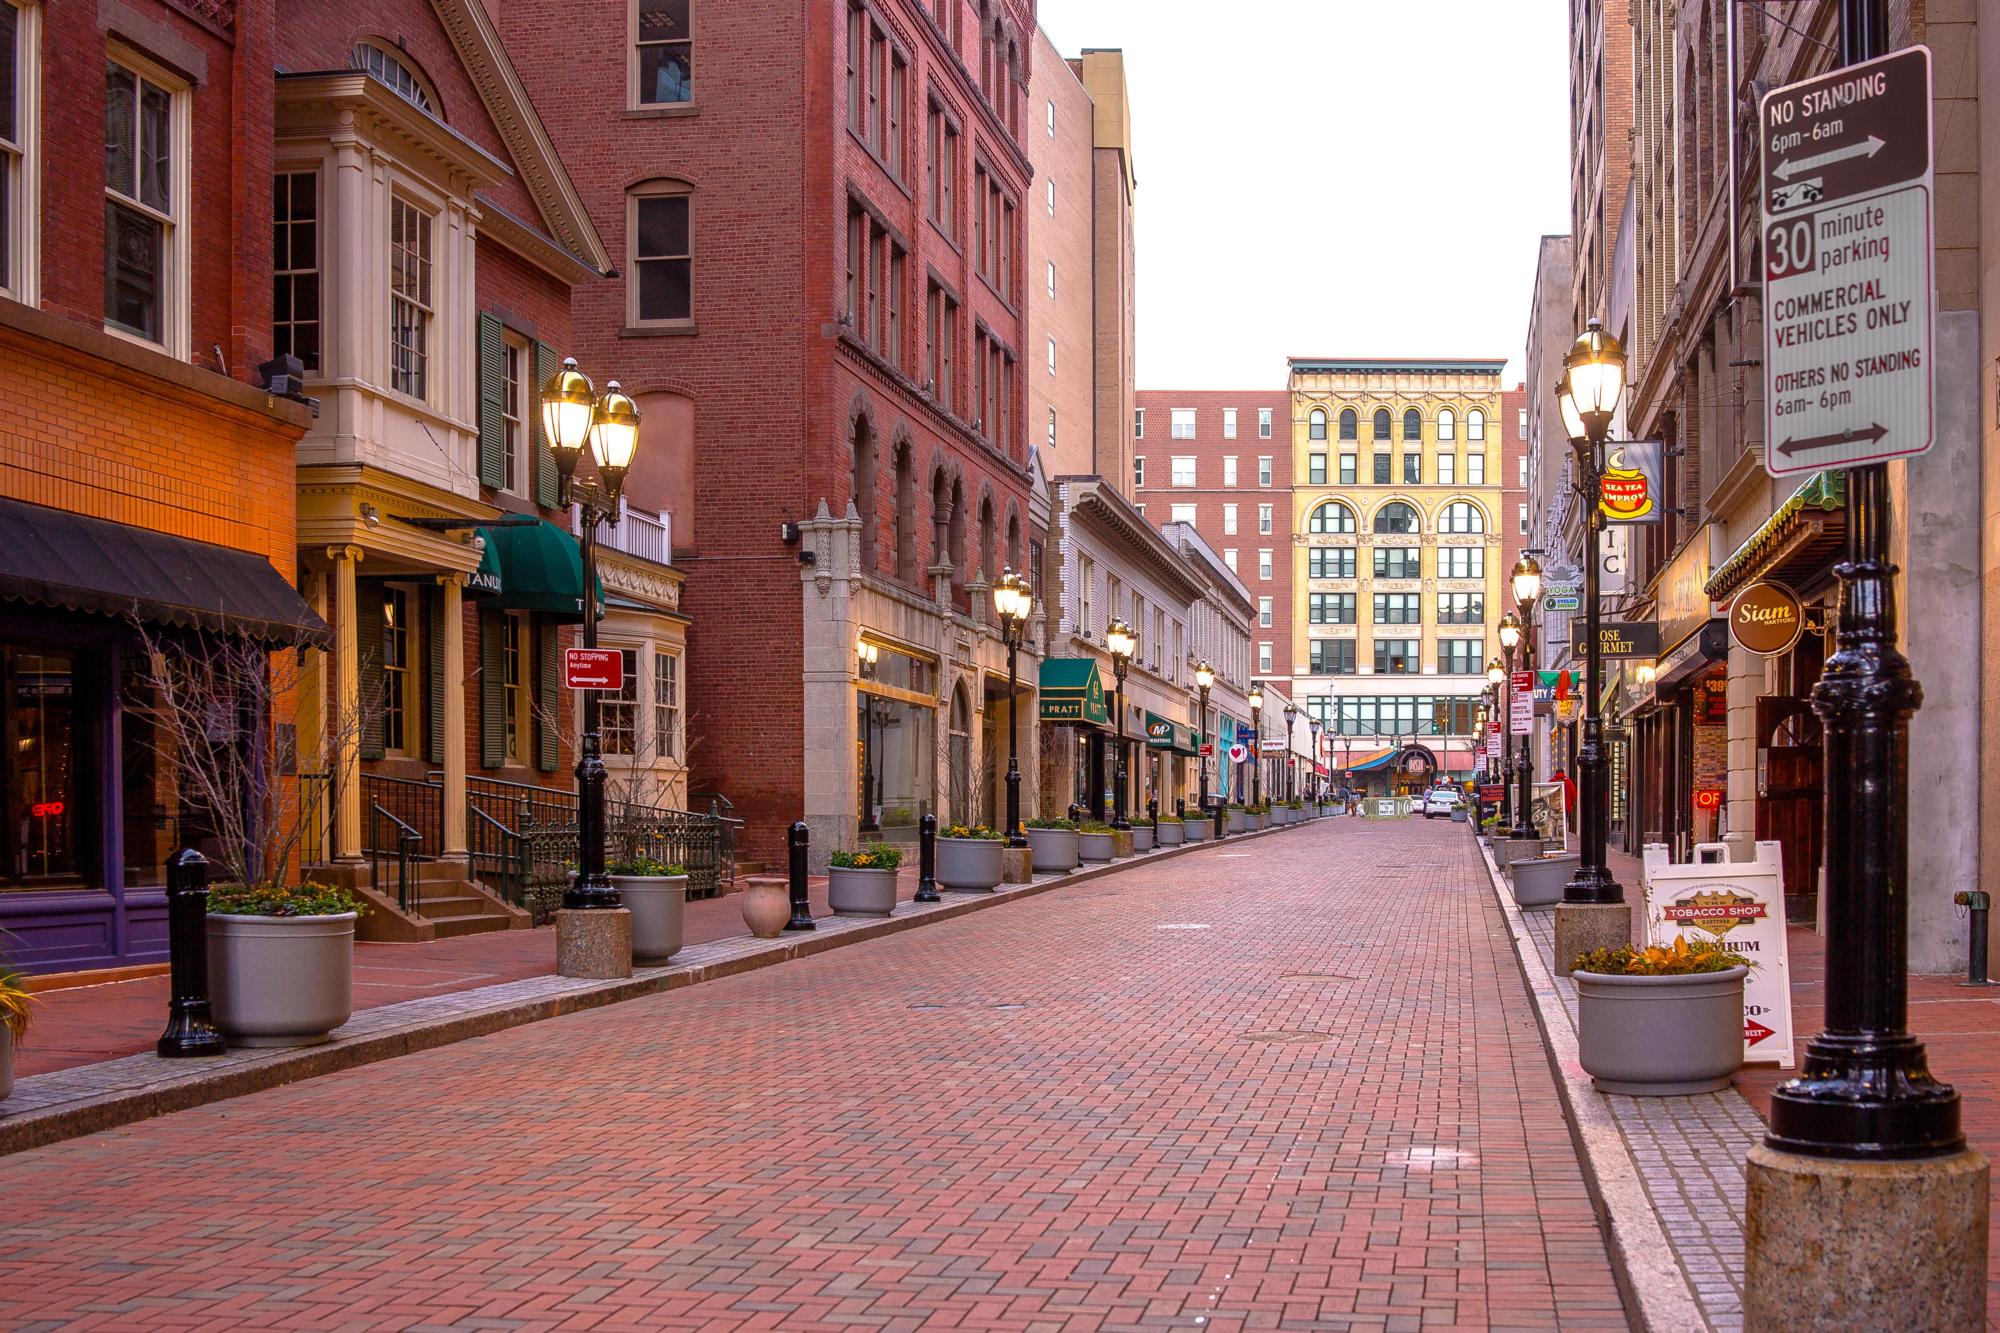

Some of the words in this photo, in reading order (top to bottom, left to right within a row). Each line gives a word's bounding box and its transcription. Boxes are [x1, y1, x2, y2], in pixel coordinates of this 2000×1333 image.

[1771, 101, 1794, 127] NO
[1802, 72, 1887, 117] STANDING
[1821, 206, 1884, 240] minute
[1769, 220, 1812, 275] 30
[1821, 236, 1889, 275] parking
[1774, 278, 1886, 321] COMMERCIAL
[1775, 312, 1857, 348] VEHICLES
[1866, 300, 1911, 330] ONLY
[1775, 367, 1825, 393] OTHERS
[1830, 362, 1849, 383] NO
[1855, 348, 1921, 378] STANDING
[1604, 491, 1645, 502] IMPROV
[1605, 483, 1623, 492] SEA
[1624, 483, 1643, 492] TEA
[1738, 603, 1791, 624] Siam
[1764, 616, 1796, 625] HARTFORD
[569, 653, 578, 661] NO
[580, 653, 609, 662] STOPPING
[569, 662, 592, 670] Anytime
[1049, 705, 1080, 713] PRATT
[1669, 907, 1725, 917] TOBACCO
[1728, 906, 1761, 915] SHOP
